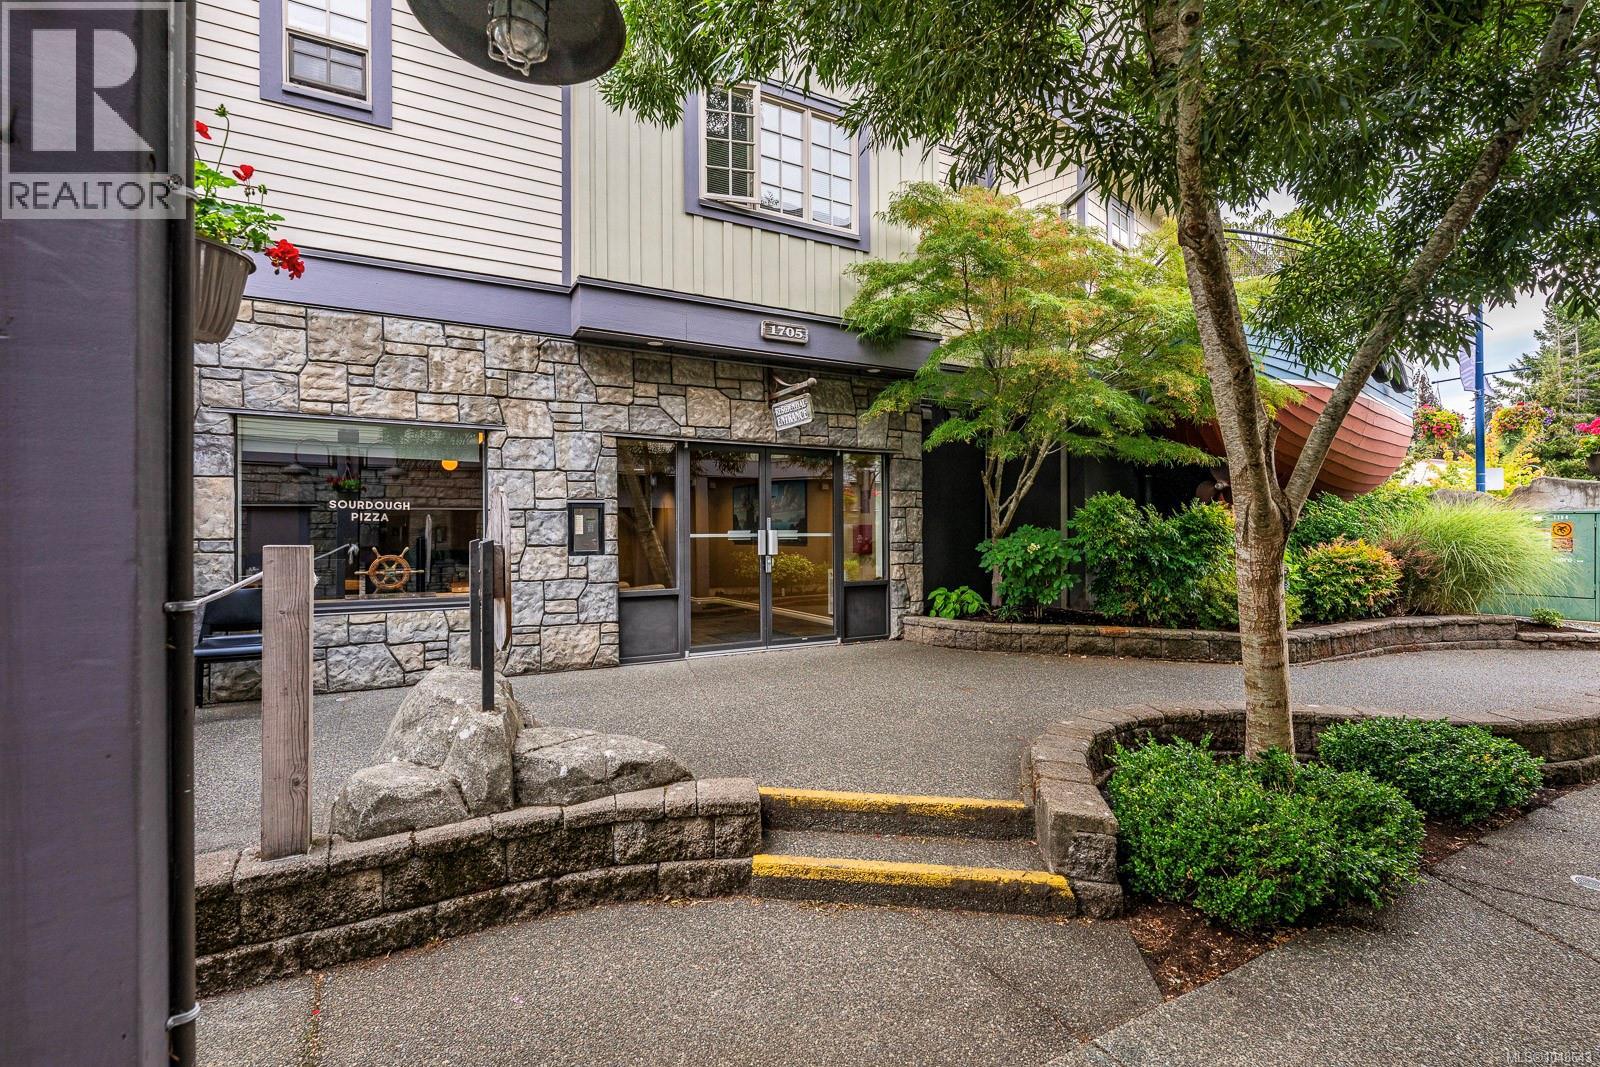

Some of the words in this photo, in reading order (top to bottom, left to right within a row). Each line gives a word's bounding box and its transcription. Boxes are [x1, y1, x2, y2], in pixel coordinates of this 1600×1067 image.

[769, 325, 804, 339] 1705
[776, 408, 809, 426] ENTRANCE
[329, 499, 411, 511] SOURDOUGH
[351, 512, 390, 522] PIZZA
